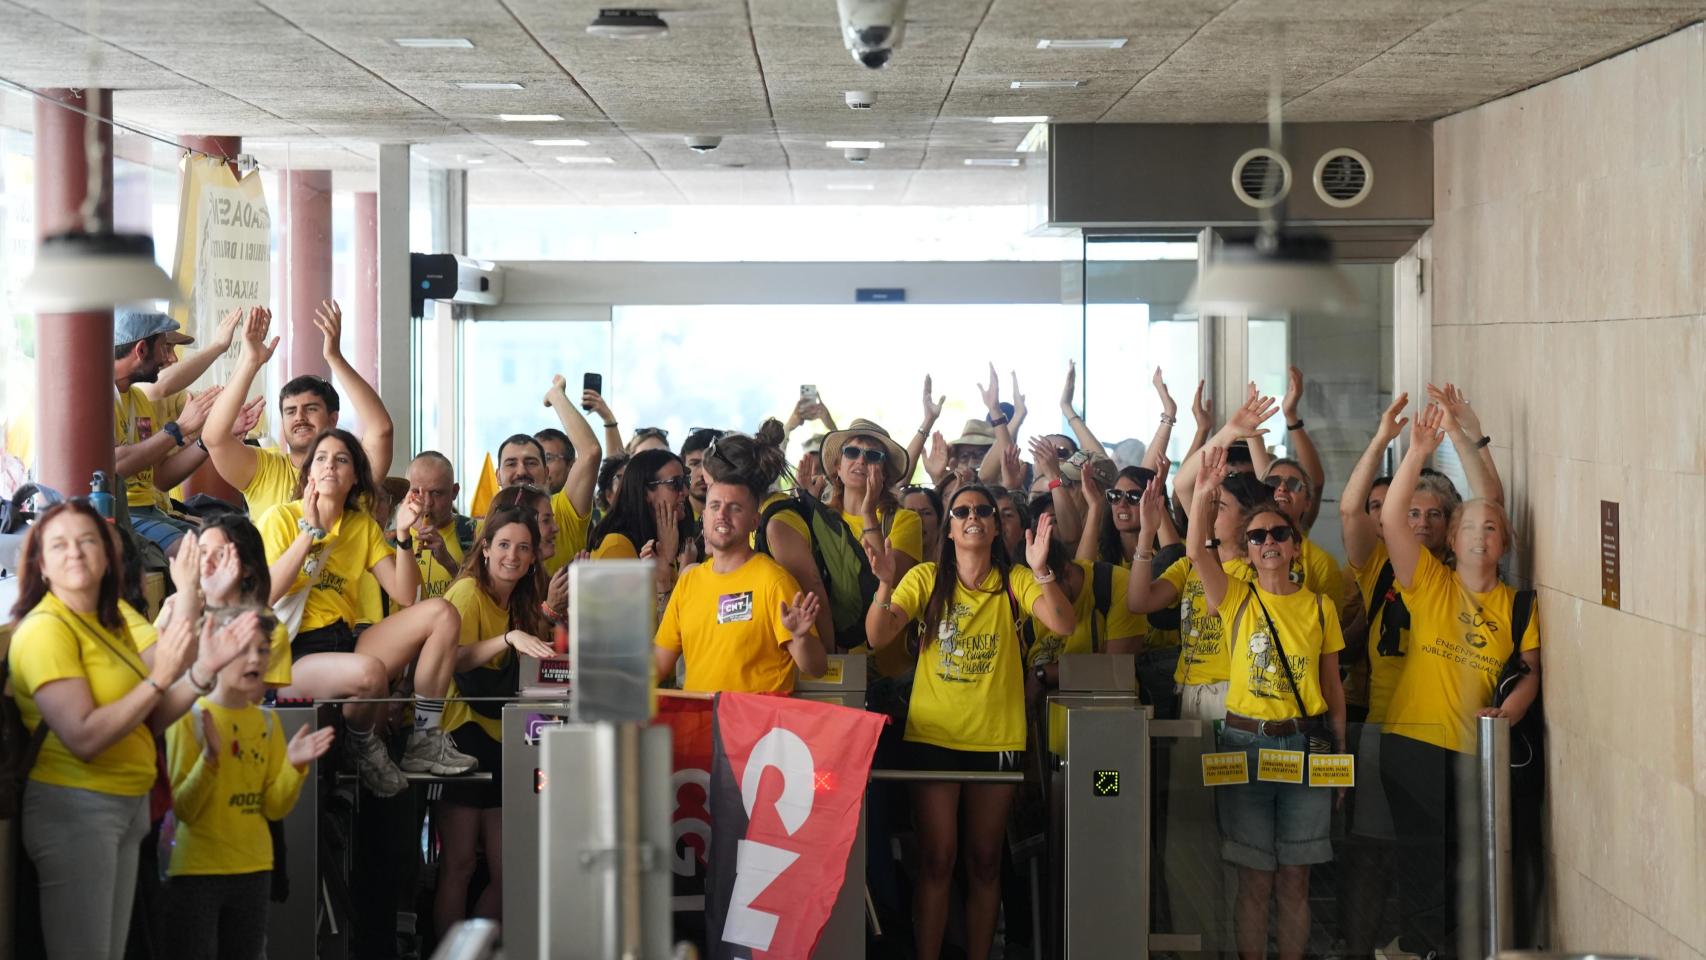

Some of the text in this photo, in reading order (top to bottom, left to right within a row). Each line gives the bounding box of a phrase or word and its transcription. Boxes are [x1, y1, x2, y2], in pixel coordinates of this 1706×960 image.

[725, 601, 744, 612] CNT
[1435, 637, 1504, 671] ENSENYAMEN
[1454, 655, 1468, 665] DE
[721, 727, 816, 960] CN
